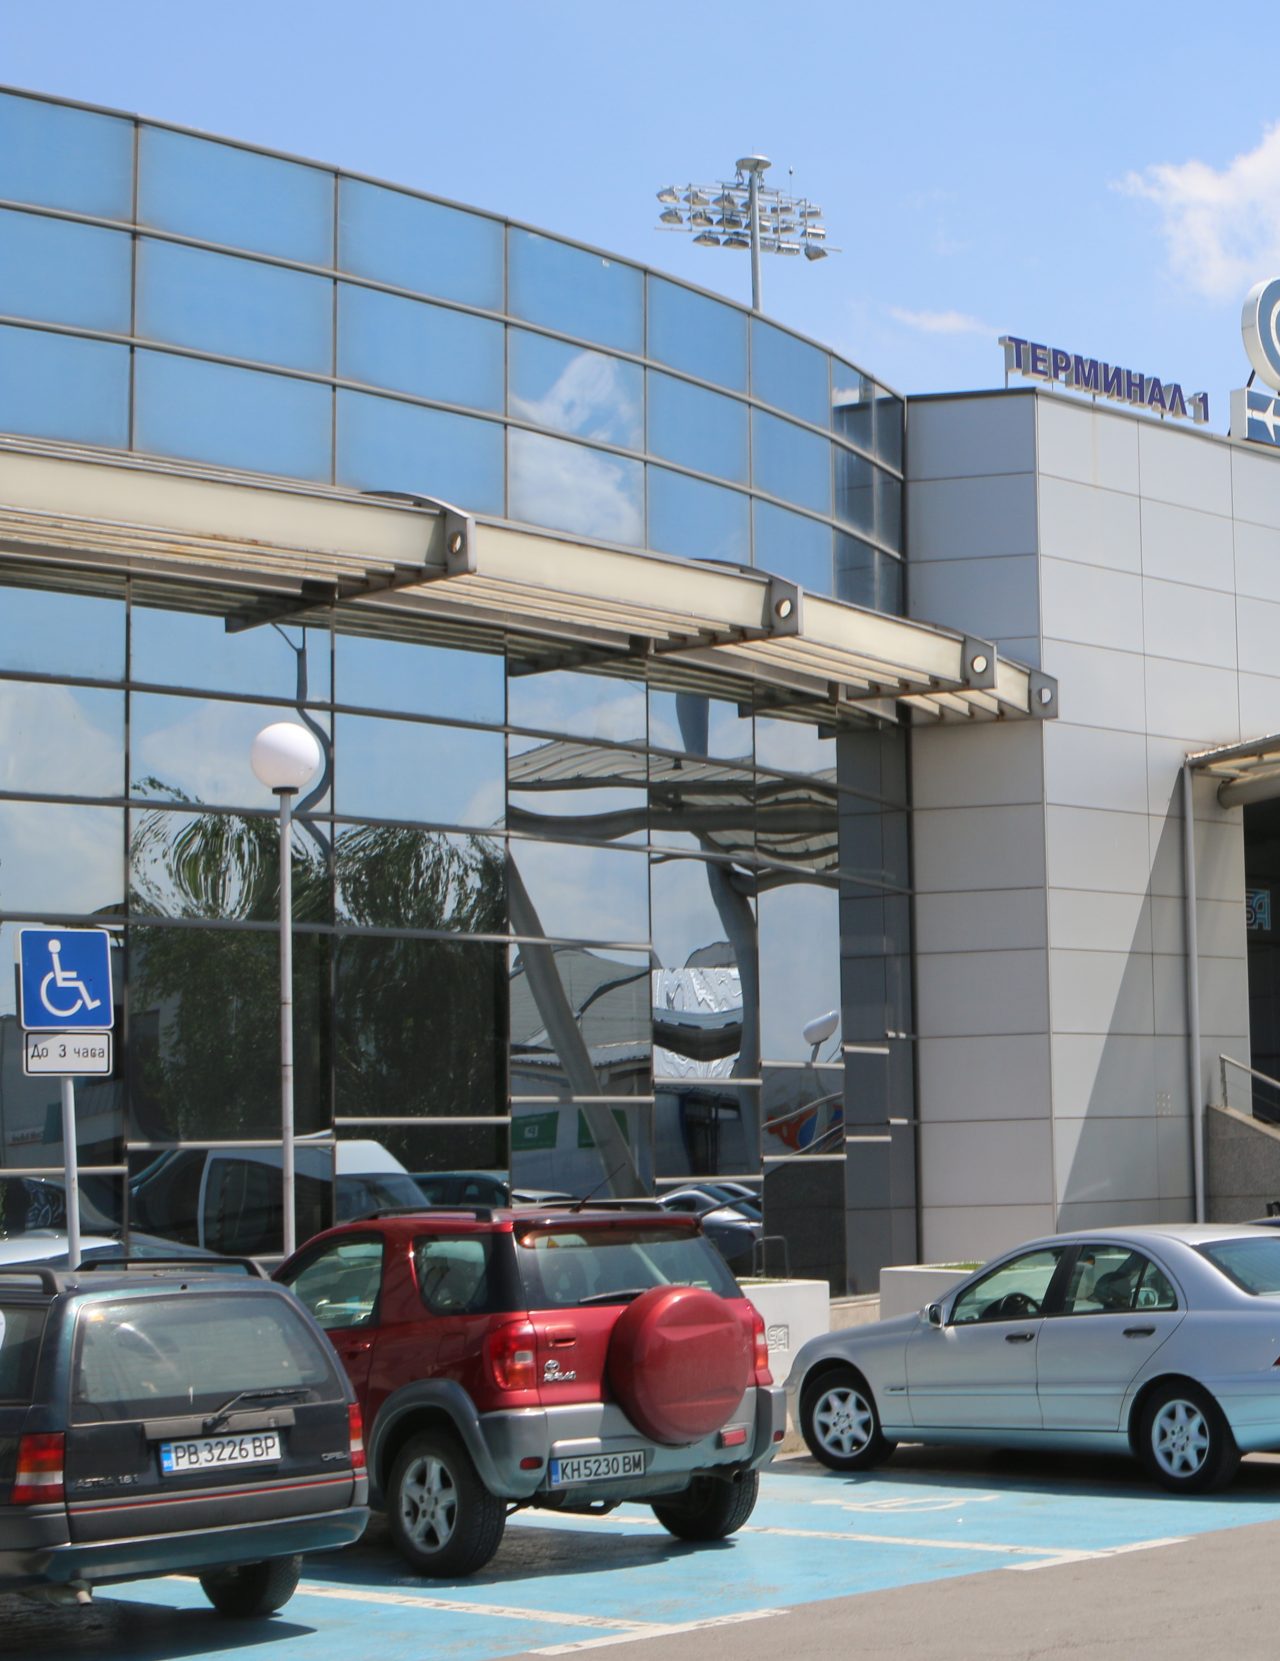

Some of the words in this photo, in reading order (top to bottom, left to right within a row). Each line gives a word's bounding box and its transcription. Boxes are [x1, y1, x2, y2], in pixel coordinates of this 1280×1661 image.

[1003, 336, 1188, 417] ТЕРМИНАЛ
[1195, 391, 1210, 422] 1
[31, 1044, 49, 1060] До
[58, 1044, 67, 1058] 3
[174, 1444, 200, 1467] PB
[203, 1439, 249, 1463] 3226
[251, 1435, 276, 1458] BP
[560, 1461, 581, 1480] KH
[583, 1457, 620, 1477] 5230
[623, 1454, 642, 1473] BM
